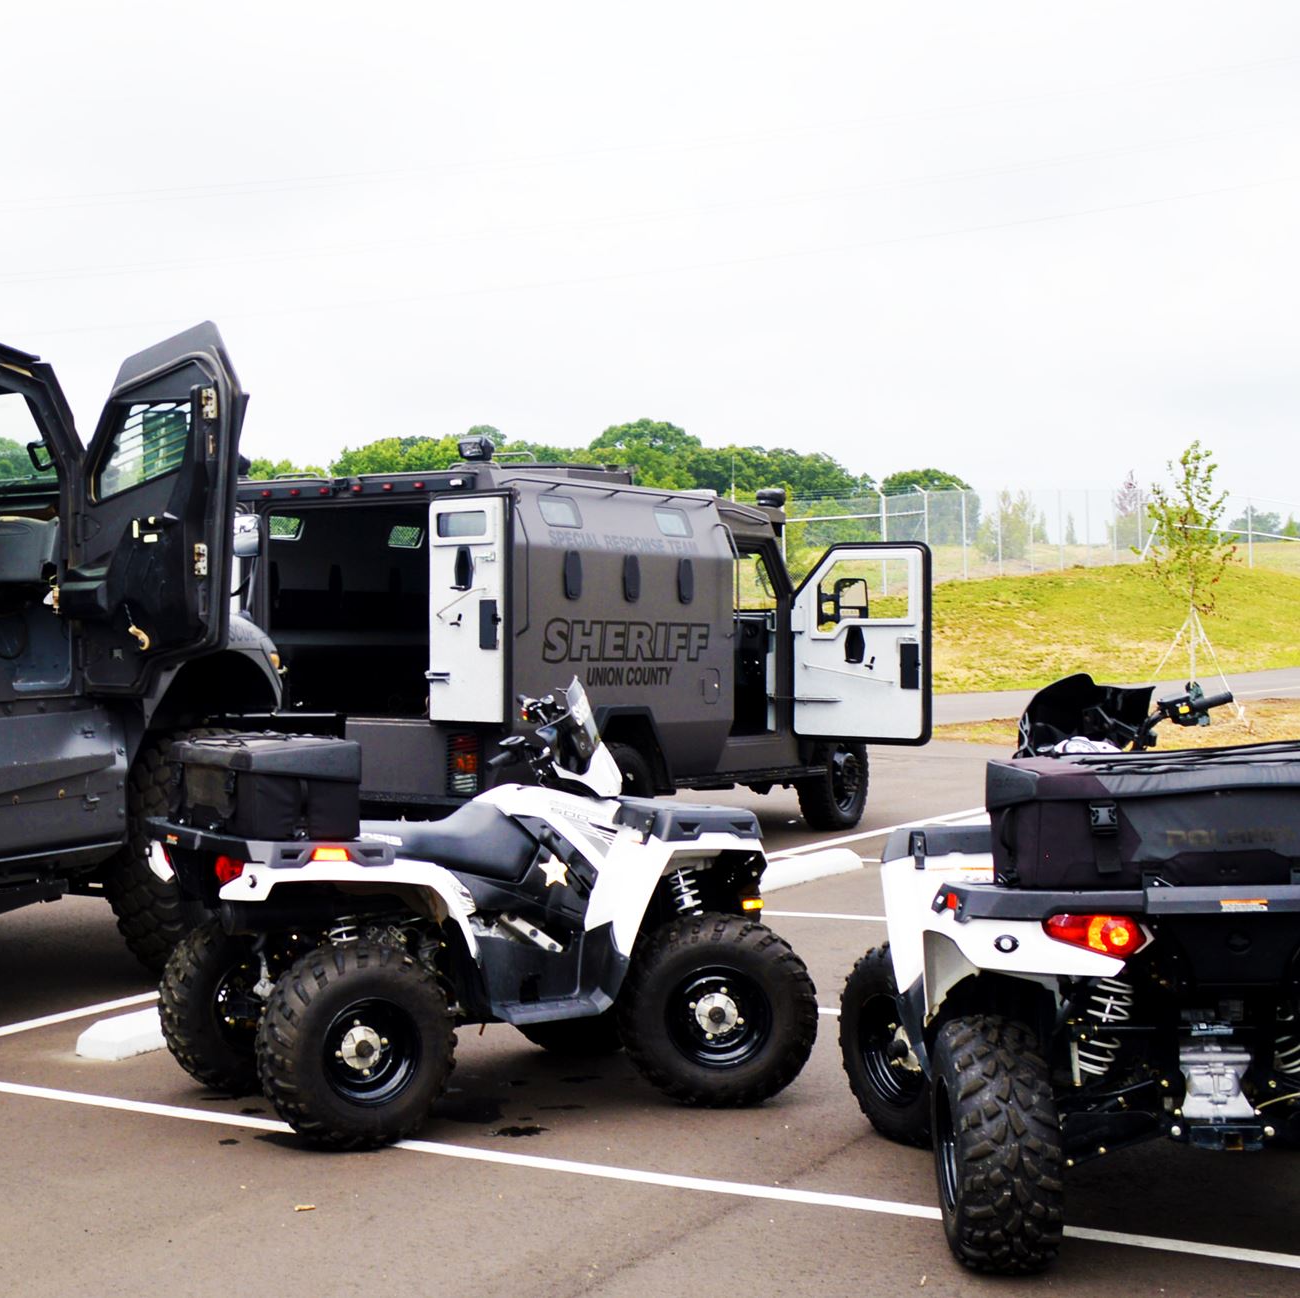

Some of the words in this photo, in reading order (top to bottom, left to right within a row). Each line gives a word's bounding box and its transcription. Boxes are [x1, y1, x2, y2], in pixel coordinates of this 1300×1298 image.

[548, 530, 599, 548] SPECIAL
[603, 535, 664, 553] RESPONSE
[667, 540, 699, 554] TEAM
[542, 617, 710, 664] SHERIFF
[586, 666, 624, 686] UNION
[626, 666, 673, 686] COUNTY
